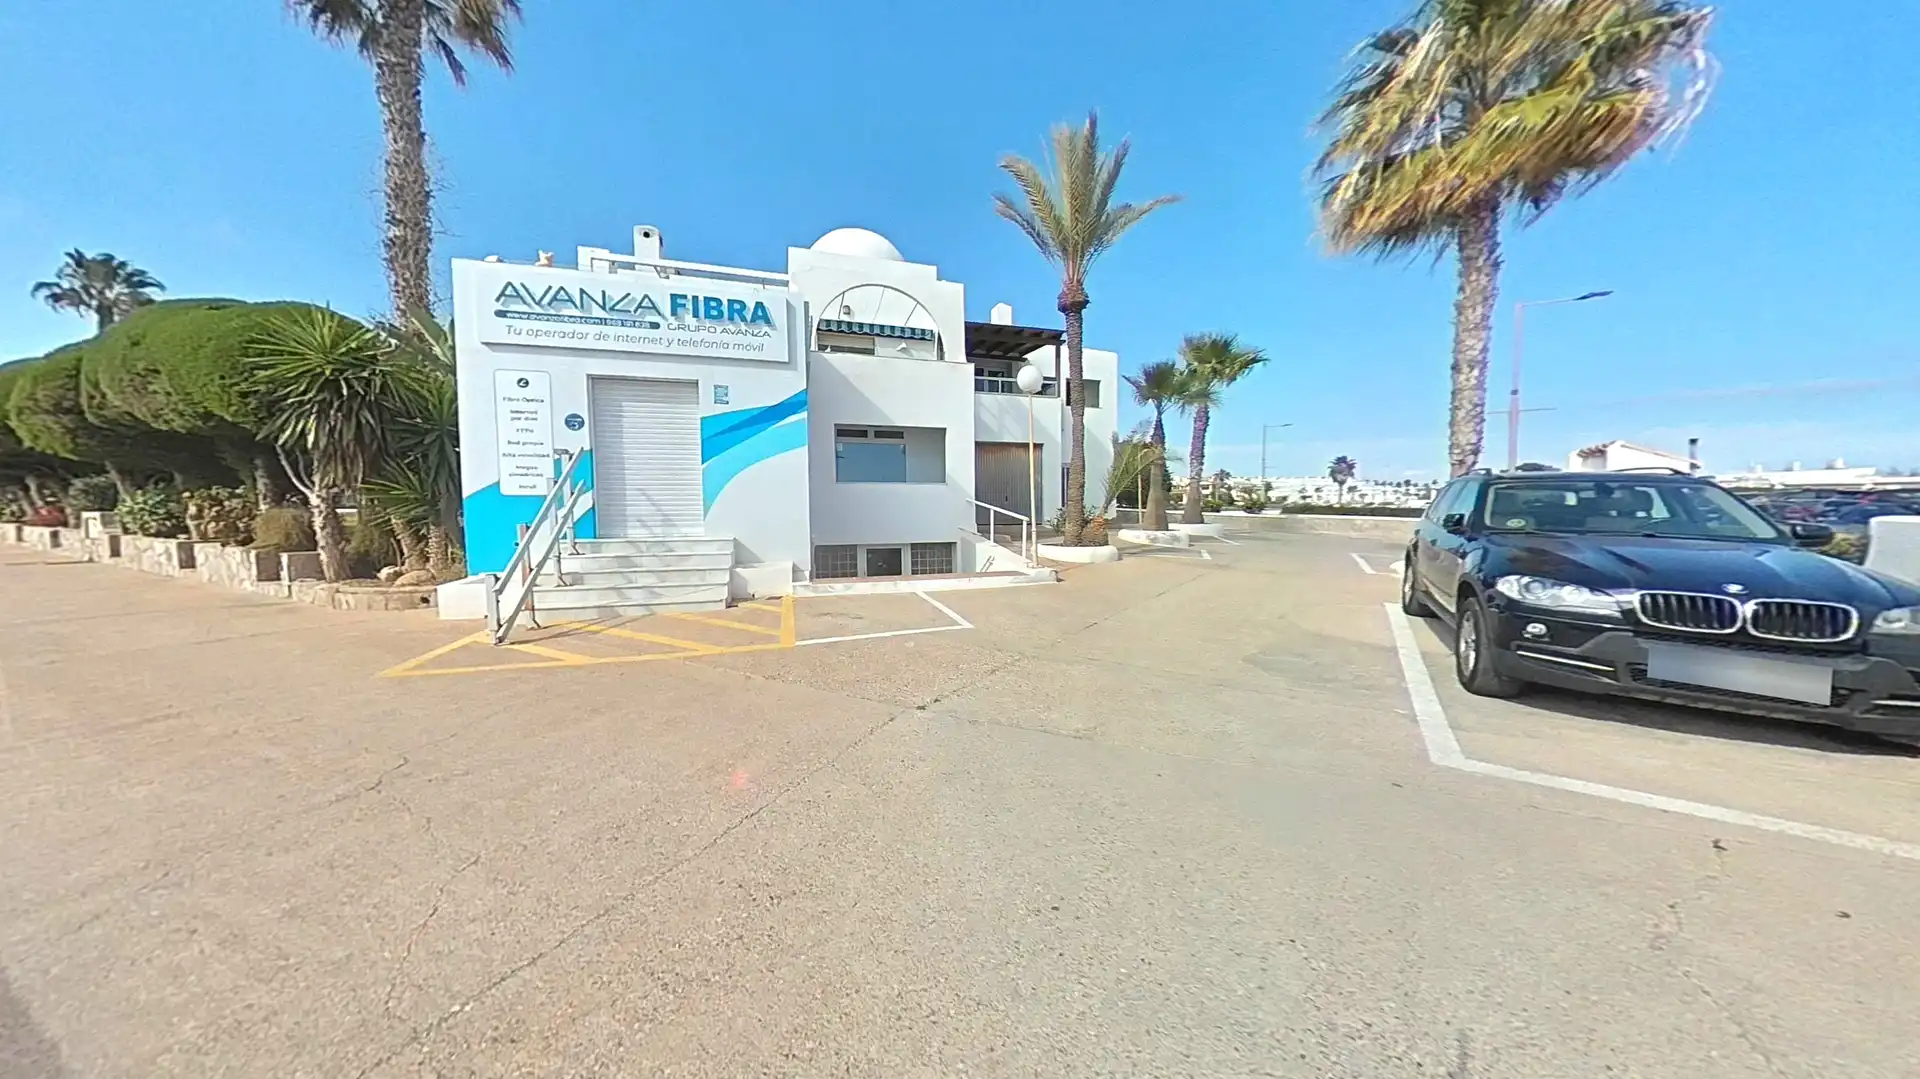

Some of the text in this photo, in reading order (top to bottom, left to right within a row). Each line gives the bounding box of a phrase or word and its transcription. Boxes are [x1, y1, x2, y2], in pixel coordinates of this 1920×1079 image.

[494, 281, 772, 325] AVANZA FIBRA
[505, 325, 765, 352] Tu operador de internet y telefonía móvil
[667, 323, 772, 338] GRUPO AVANZA
